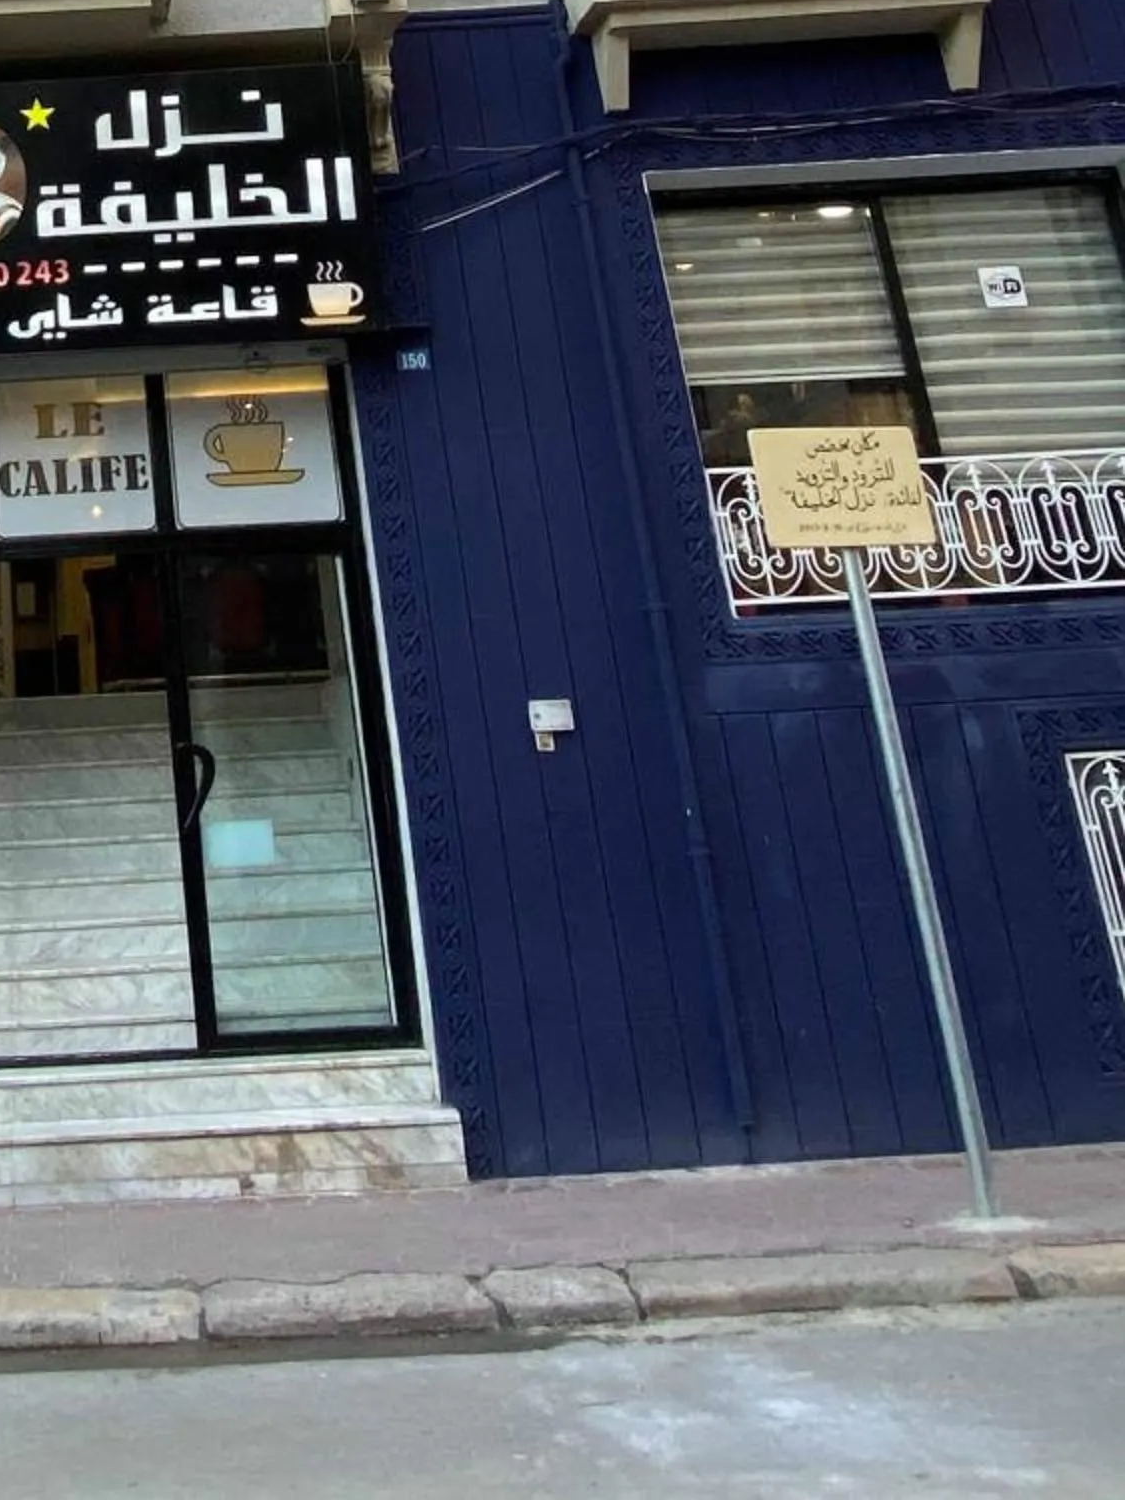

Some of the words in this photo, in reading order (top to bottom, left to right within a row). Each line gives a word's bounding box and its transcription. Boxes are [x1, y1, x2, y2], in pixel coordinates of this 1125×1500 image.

[95, 89, 284, 157] نزل
[36, 157, 357, 244] الخليفة
[16, 258, 71, 285] 243
[8, 292, 124, 340] شاي
[147, 284, 278, 324] قاعة
[35, 402, 106, 439] LE
